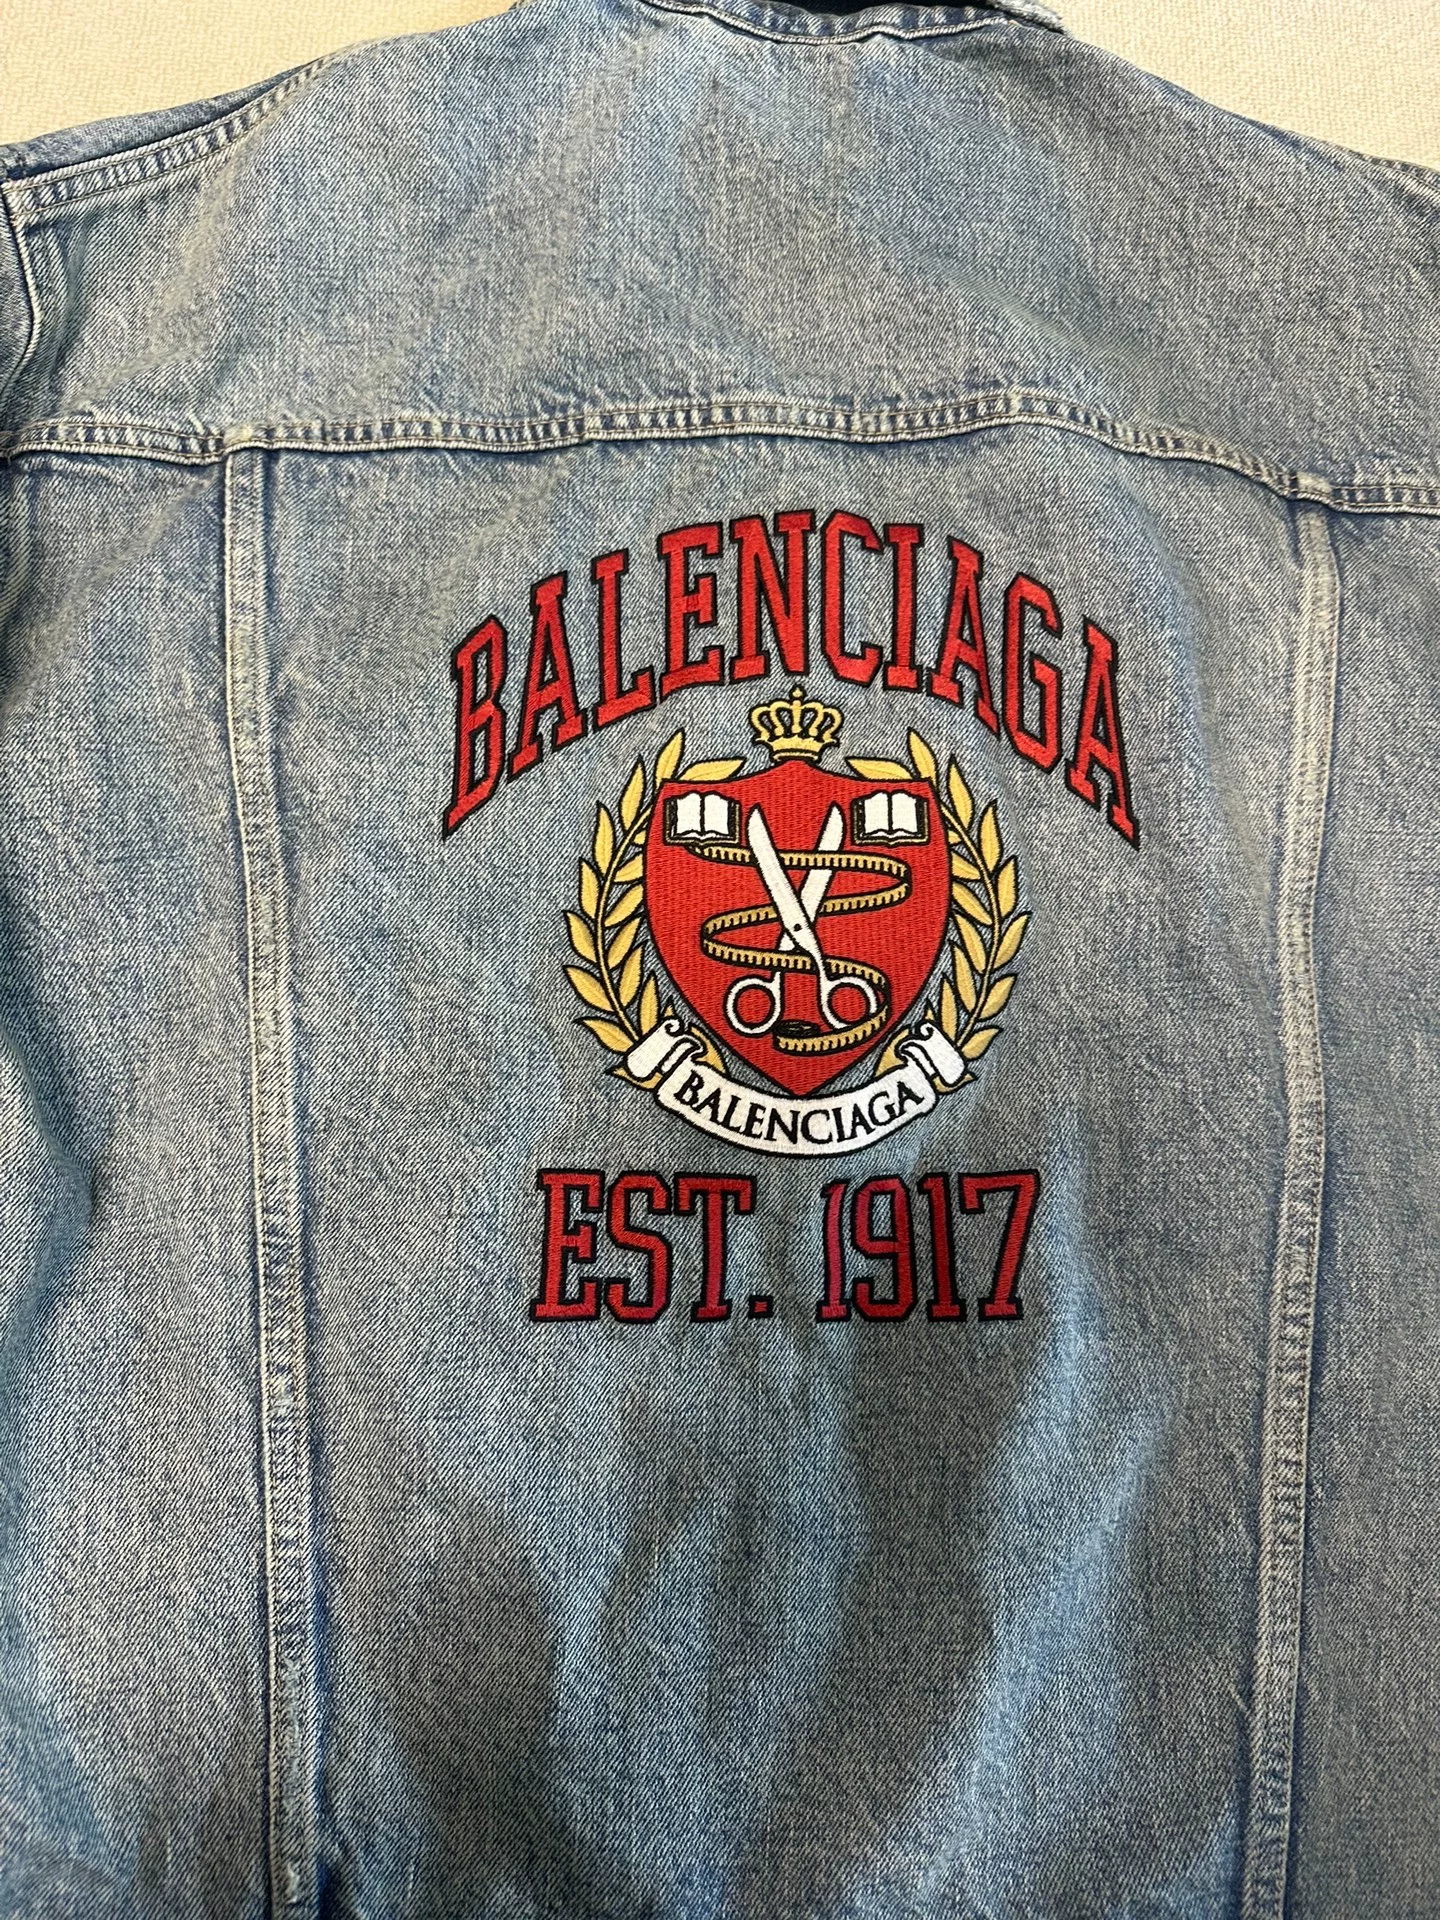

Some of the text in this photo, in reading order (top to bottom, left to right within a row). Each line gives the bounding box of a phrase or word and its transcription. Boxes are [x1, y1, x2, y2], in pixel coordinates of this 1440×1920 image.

[442, 508, 1141, 852] BALENCIAGA
[673, 1069, 924, 1145] BALENCIAGA
[531, 1168, 1042, 1323] EST. 1917
